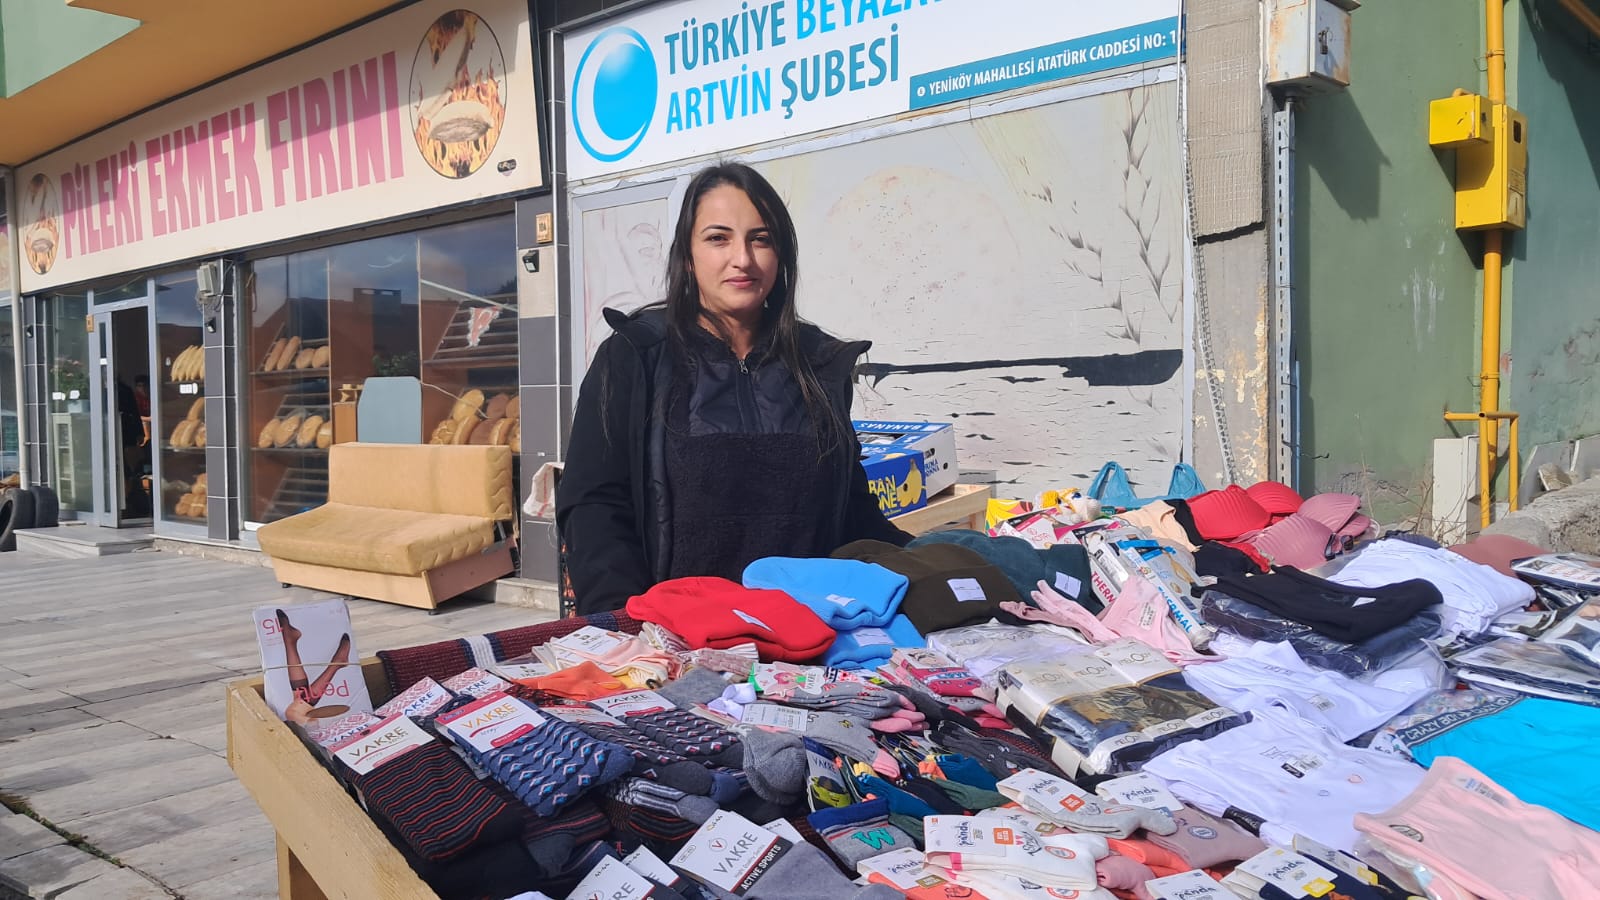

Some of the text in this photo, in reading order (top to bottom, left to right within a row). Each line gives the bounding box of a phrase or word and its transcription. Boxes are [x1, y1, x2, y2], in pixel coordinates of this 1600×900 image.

[664, 0, 944, 75] TÜRKİYE BEYA
[666, 23, 899, 134] ARTVİN ŞUBESİ
[929, 73, 972, 96] YENİKÖY
[974, 57, 1034, 86] MAHALLESİ
[1037, 48, 1087, 73] ATATÜRK
[1089, 34, 1140, 60] CADDESİ
[1144, 32, 1166, 50] NO:
[61, 51, 404, 259] PİLEKİ EKMEK FIRINI
[262, 616, 284, 636] 15
[404, 692, 434, 716] AKRE
[458, 679, 491, 695] AKRE
[461, 703, 515, 729] VAKRE
[1404, 720, 1441, 741] CRAZY
[349, 726, 404, 758] VAKRE
[713, 831, 758, 874] VAKRE
[740, 862, 763, 890] ACTIVE
[759, 844, 782, 869] SPORTS
